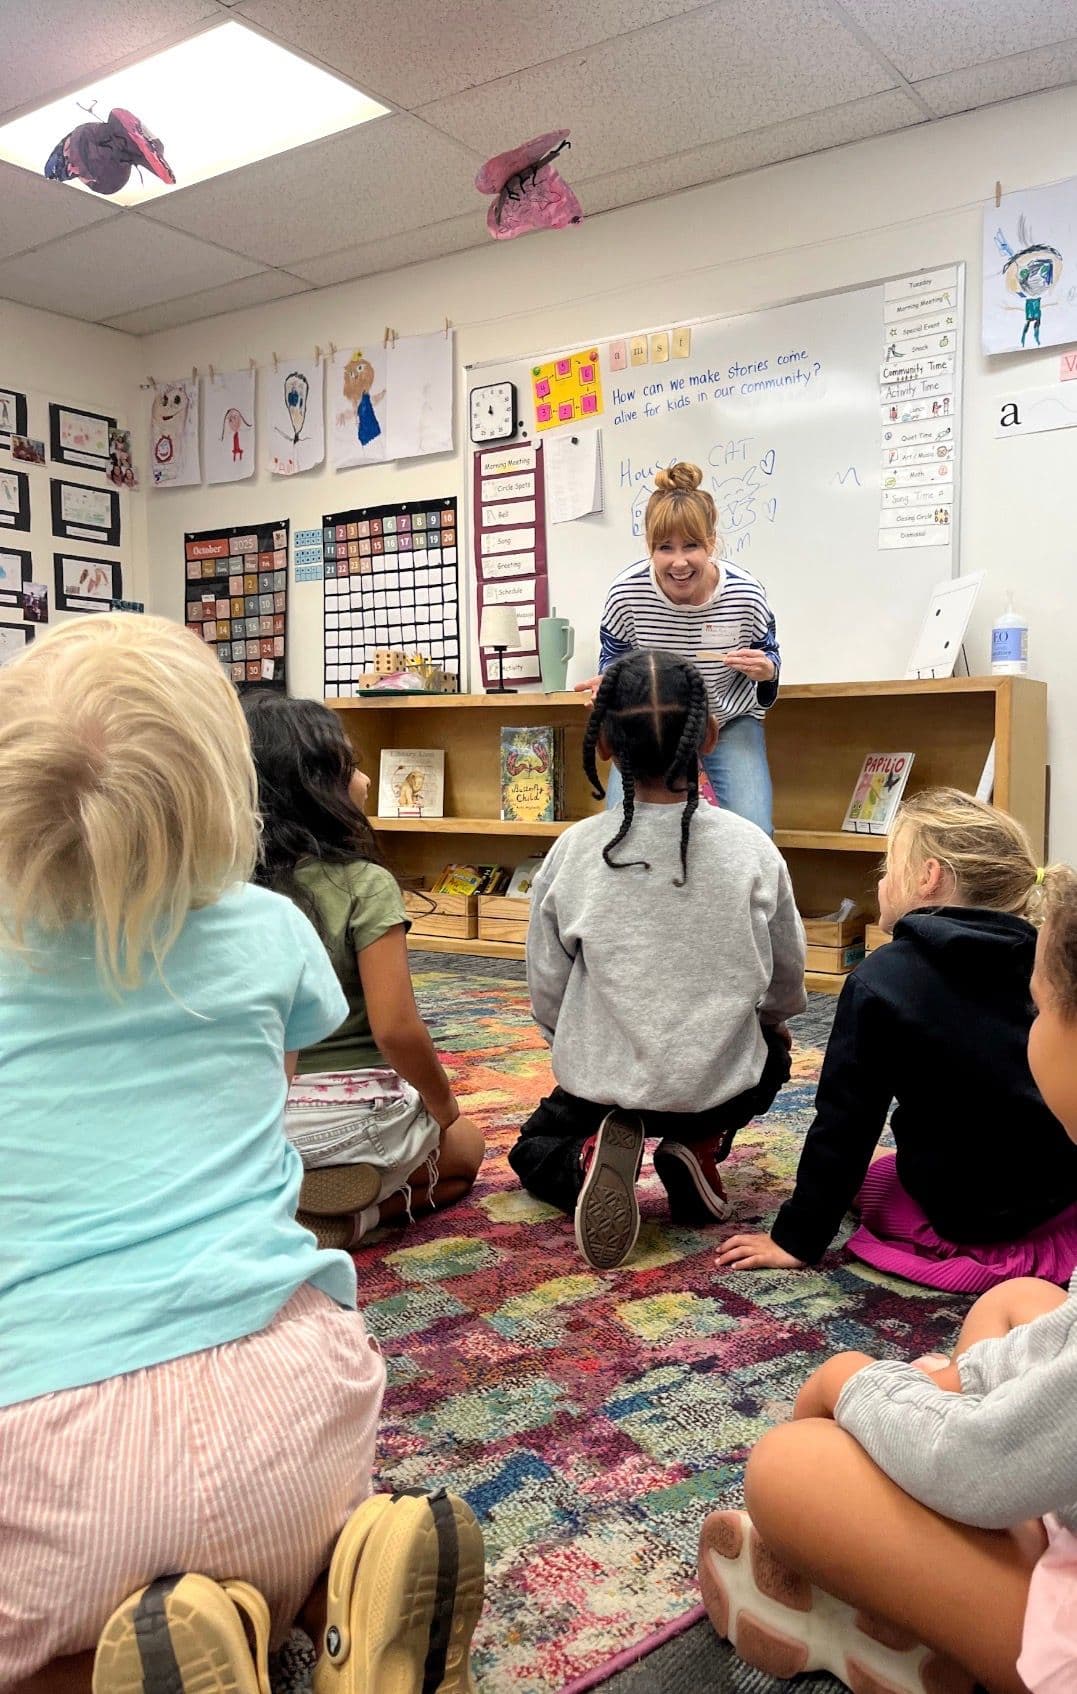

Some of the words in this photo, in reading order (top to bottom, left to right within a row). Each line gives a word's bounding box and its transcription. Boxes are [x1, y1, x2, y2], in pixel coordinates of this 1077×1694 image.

[896, 303, 919, 313] Morning
[920, 297, 943, 307] Meeting
[903, 325, 922, 336] Special
[924, 321, 940, 331] Event
[614, 352, 620, 360] a
[633, 347, 643, 356] m
[657, 344, 662, 352] s
[883, 363, 924, 379] Community
[928, 361, 948, 371] Time
[612, 388, 636, 406] How
[643, 383, 664, 397] can
[670, 378, 685, 391] we
[689, 369, 721, 386] make
[728, 360, 769, 379] stories
[777, 350, 809, 366] come
[614, 410, 637, 425] alive
[643, 402, 661, 418] for
[667, 395, 691, 411] kids
[698, 391, 708, 402] in
[714, 386, 735, 399] our
[741, 362, 821, 394] community?
[886, 382, 917, 399] Activity
[920, 379, 940, 392] Time
[1000, 401, 1021, 427] a
[901, 434, 917, 442] Quiet
[708, 437, 755, 467] CAT
[484, 461, 507, 471] Morning
[508, 457, 531, 467] Meeting
[497, 483, 513, 492] Circle
[916, 513, 933, 521] Circle
[339, 528, 344, 537] 2
[350, 526, 355, 536] 3
[373, 522, 379, 531] 5
[387, 520, 393, 529] 6
[400, 518, 406, 528] 7
[416, 517, 422, 526] 8
[431, 515, 437, 525] 9
[444, 514, 452, 523] 10
[192, 544, 222, 555] October
[233, 539, 254, 551] 2025
[326, 546, 334, 554] 11
[338, 547, 346, 555] 12
[350, 545, 357, 554] 13
[373, 541, 382, 550] 15
[387, 538, 395, 547] 16
[400, 537, 410, 546] 17
[415, 536, 424, 545] 18
[430, 535, 438, 544] 19
[443, 533, 453, 542] 20
[497, 537, 512, 546] Song
[326, 565, 334, 574] 21
[338, 564, 346, 573] 22
[351, 561, 358, 570] 23
[361, 561, 369, 570] 24
[497, 561, 521, 570] Greeting
[247, 580, 253, 589] 2
[263, 578, 269, 587] 3
[498, 587, 523, 596] Schedule
[248, 601, 254, 610] 9
[261, 599, 271, 609] 10
[220, 626, 227, 634] 14
[234, 624, 243, 633] 15
[262, 621, 271, 630] 17
[993, 631, 1009, 643] EO
[220, 648, 228, 657] 21
[263, 643, 272, 653] 24
[233, 667, 242, 676] 29
[249, 666, 258, 675] 30
[511, 783, 545, 795] Butterfly
[516, 791, 540, 803] Child
